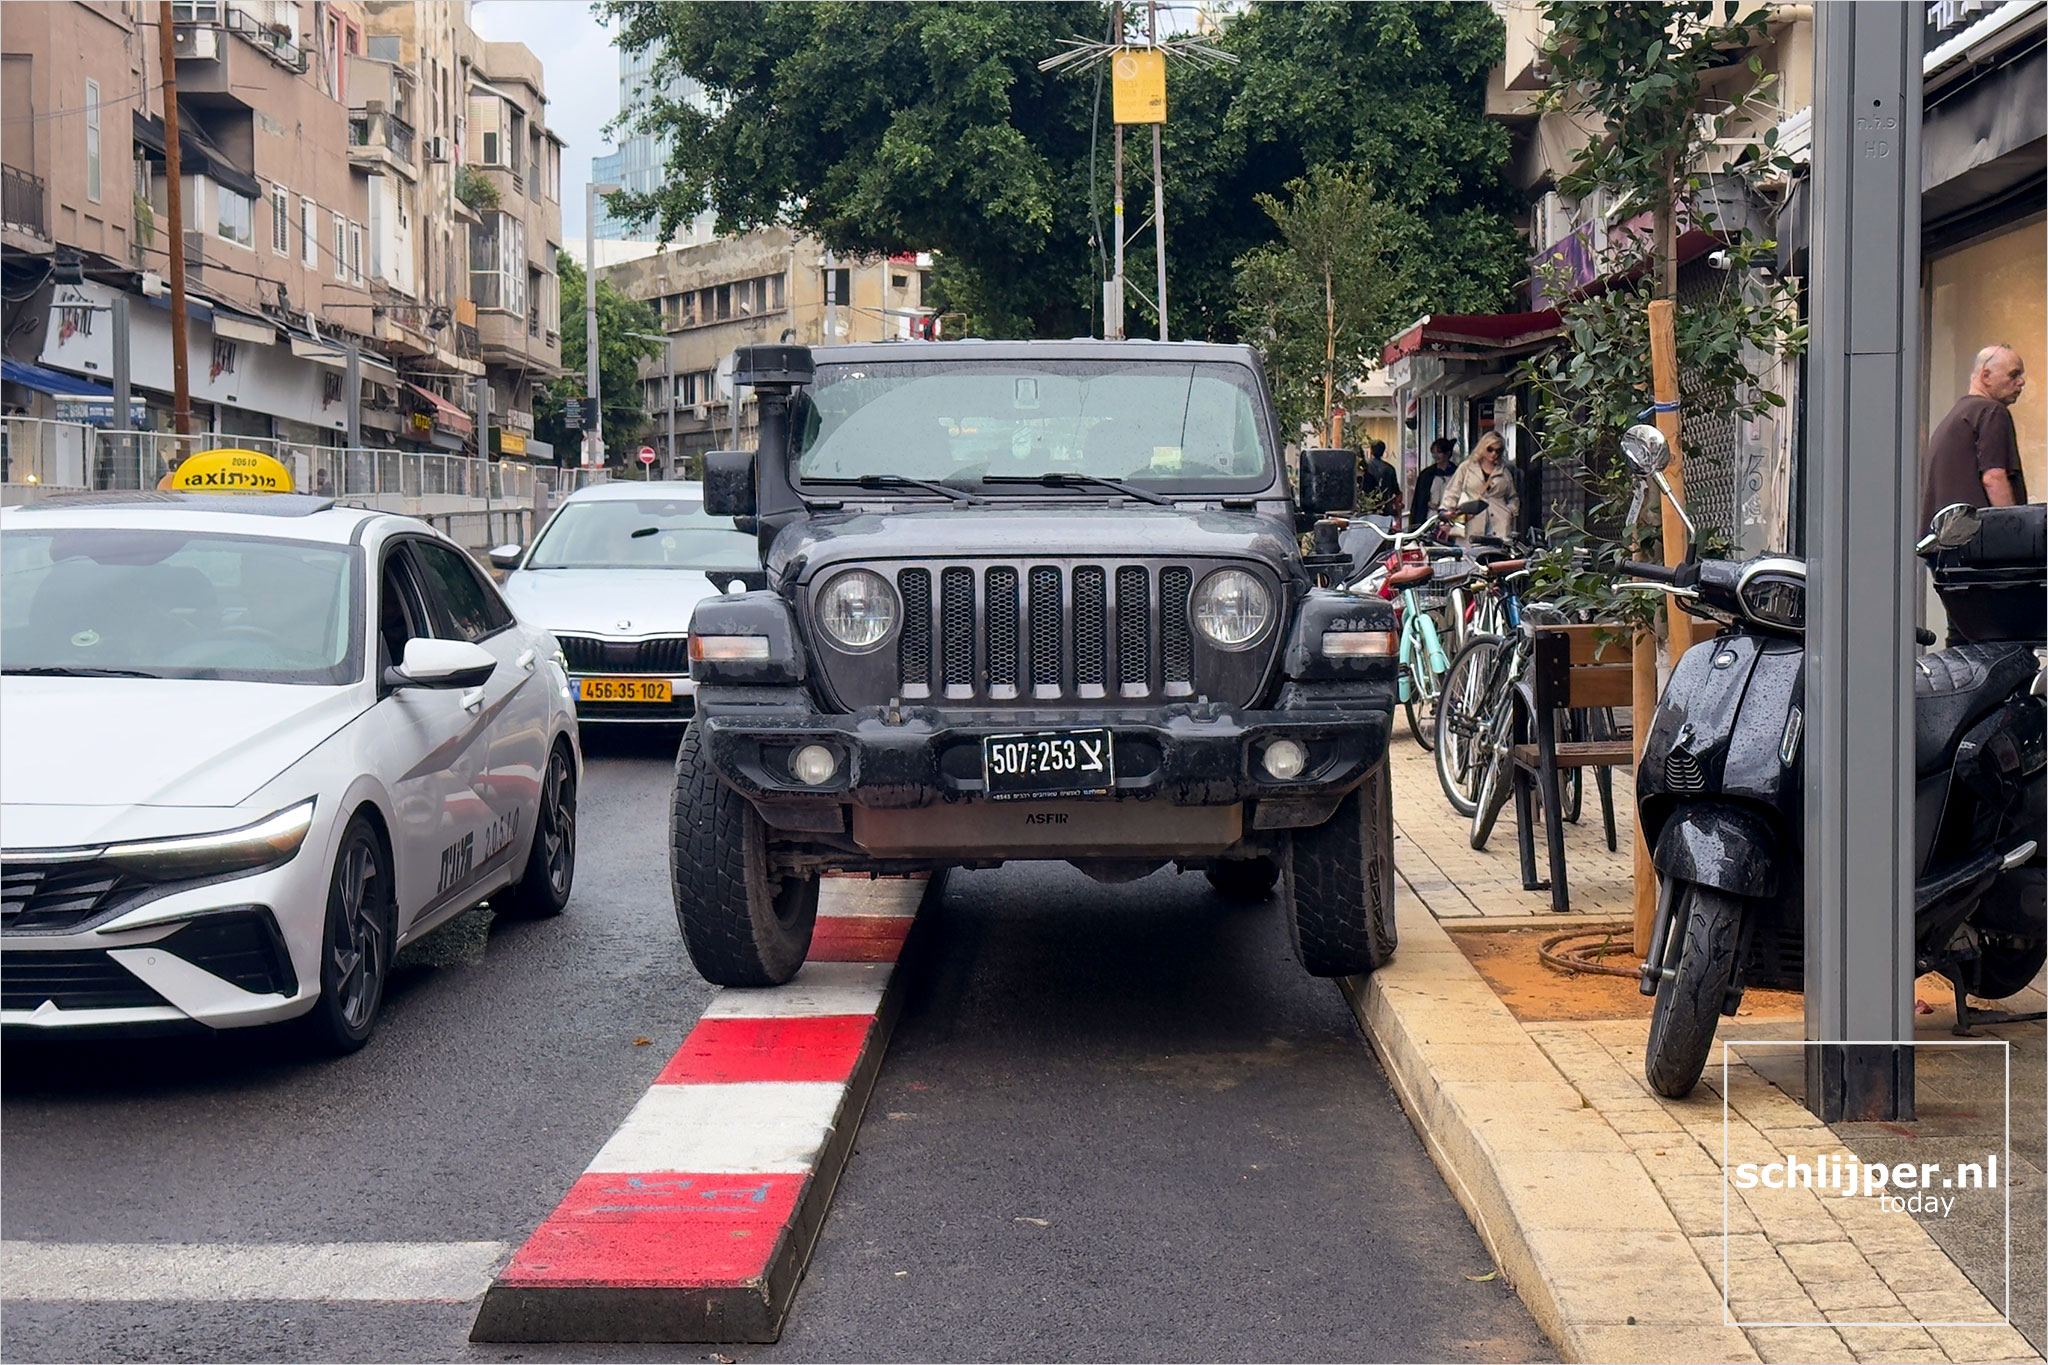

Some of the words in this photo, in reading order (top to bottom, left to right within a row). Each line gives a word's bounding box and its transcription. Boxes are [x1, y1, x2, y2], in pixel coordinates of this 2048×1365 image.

[1864, 140, 1890, 158] HD
[184, 468, 226, 486] taxi
[227, 472, 276, 487] מונית
[1025, 813, 1069, 824] ASFIR
